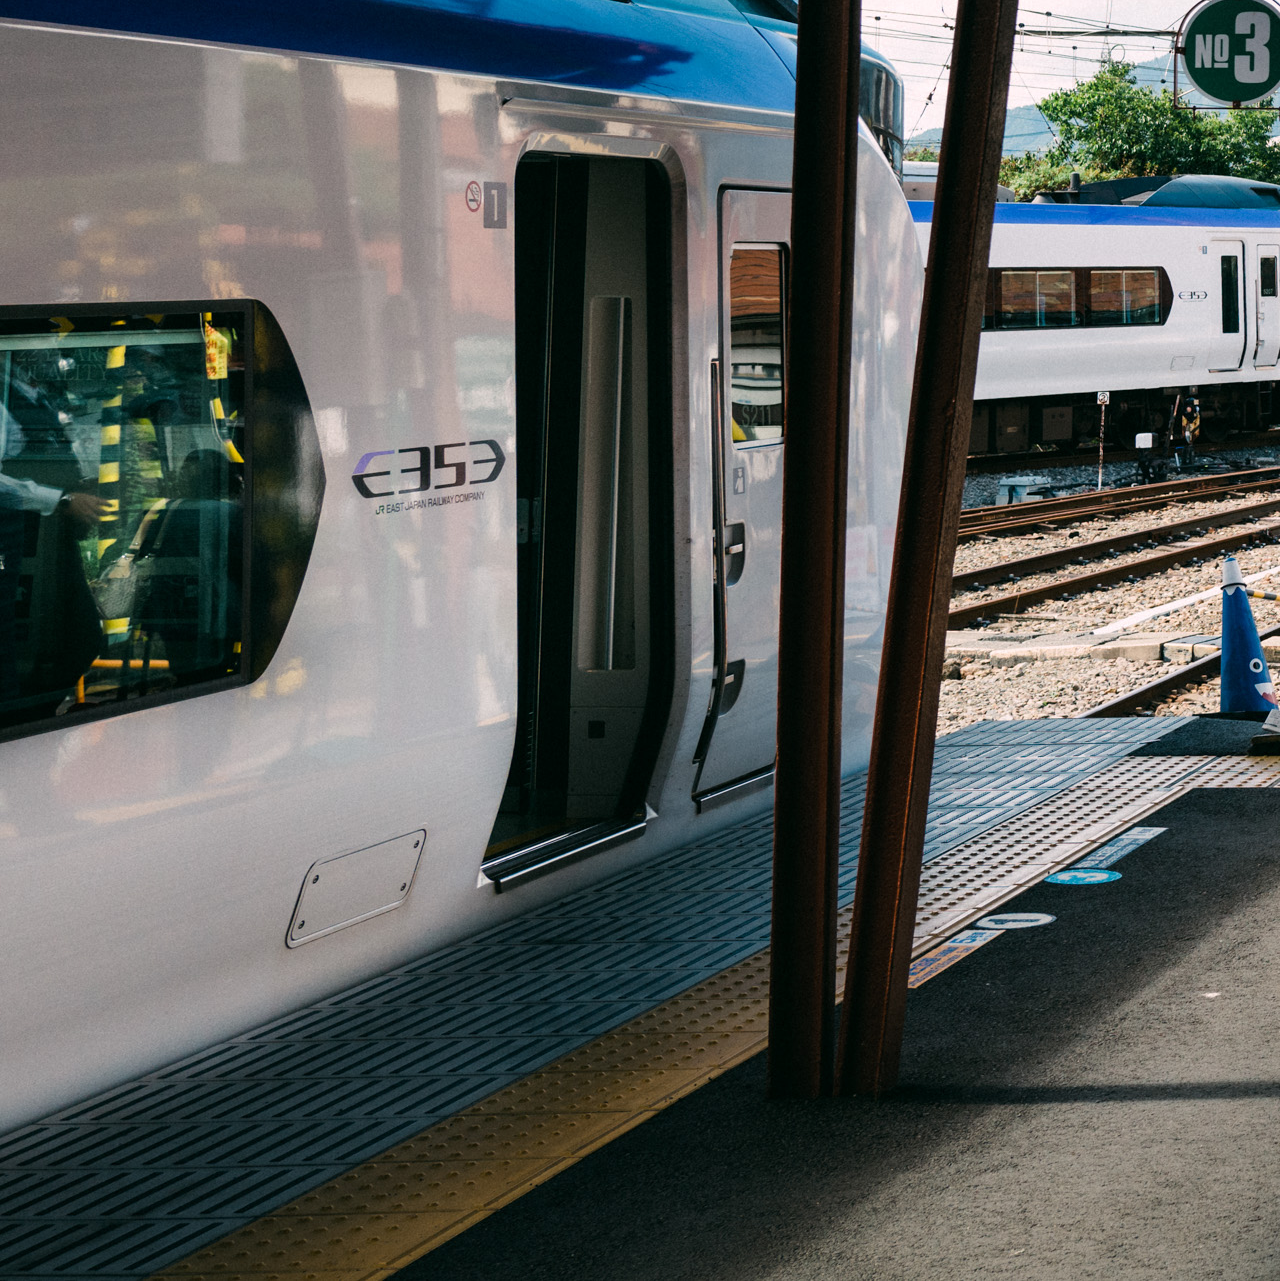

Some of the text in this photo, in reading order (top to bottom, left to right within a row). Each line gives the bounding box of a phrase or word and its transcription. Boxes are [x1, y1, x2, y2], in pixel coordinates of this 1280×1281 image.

[1233, 10, 1272, 85] 3
[740, 404, 772, 428] S211
[351, 438, 507, 499] E353
[375, 490, 486, 516] JR EAST JAPAN RAILWAY COMPANY
